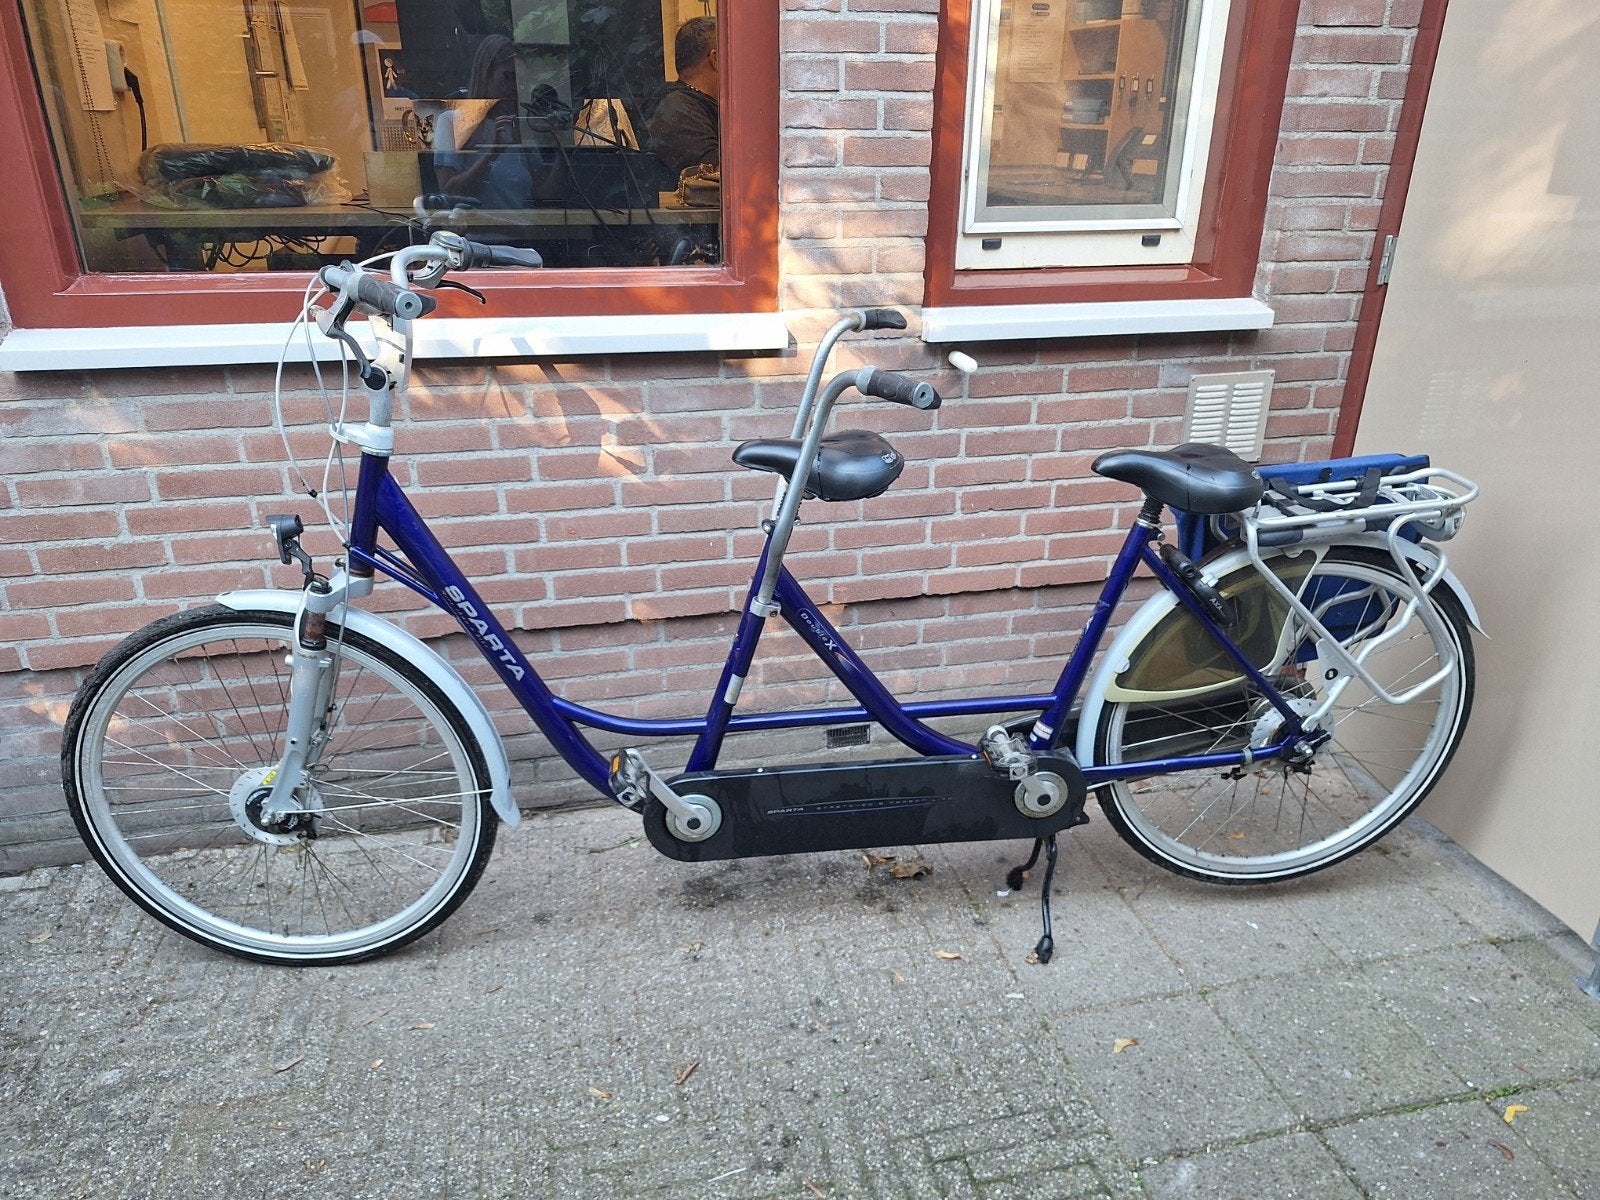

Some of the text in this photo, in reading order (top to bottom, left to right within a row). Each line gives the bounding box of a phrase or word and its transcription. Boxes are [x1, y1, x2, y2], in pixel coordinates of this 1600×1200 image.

[1210, 598, 1222, 610] AXA
[445, 585, 525, 681] SPARTA
[766, 807, 804, 815] SPARTA
